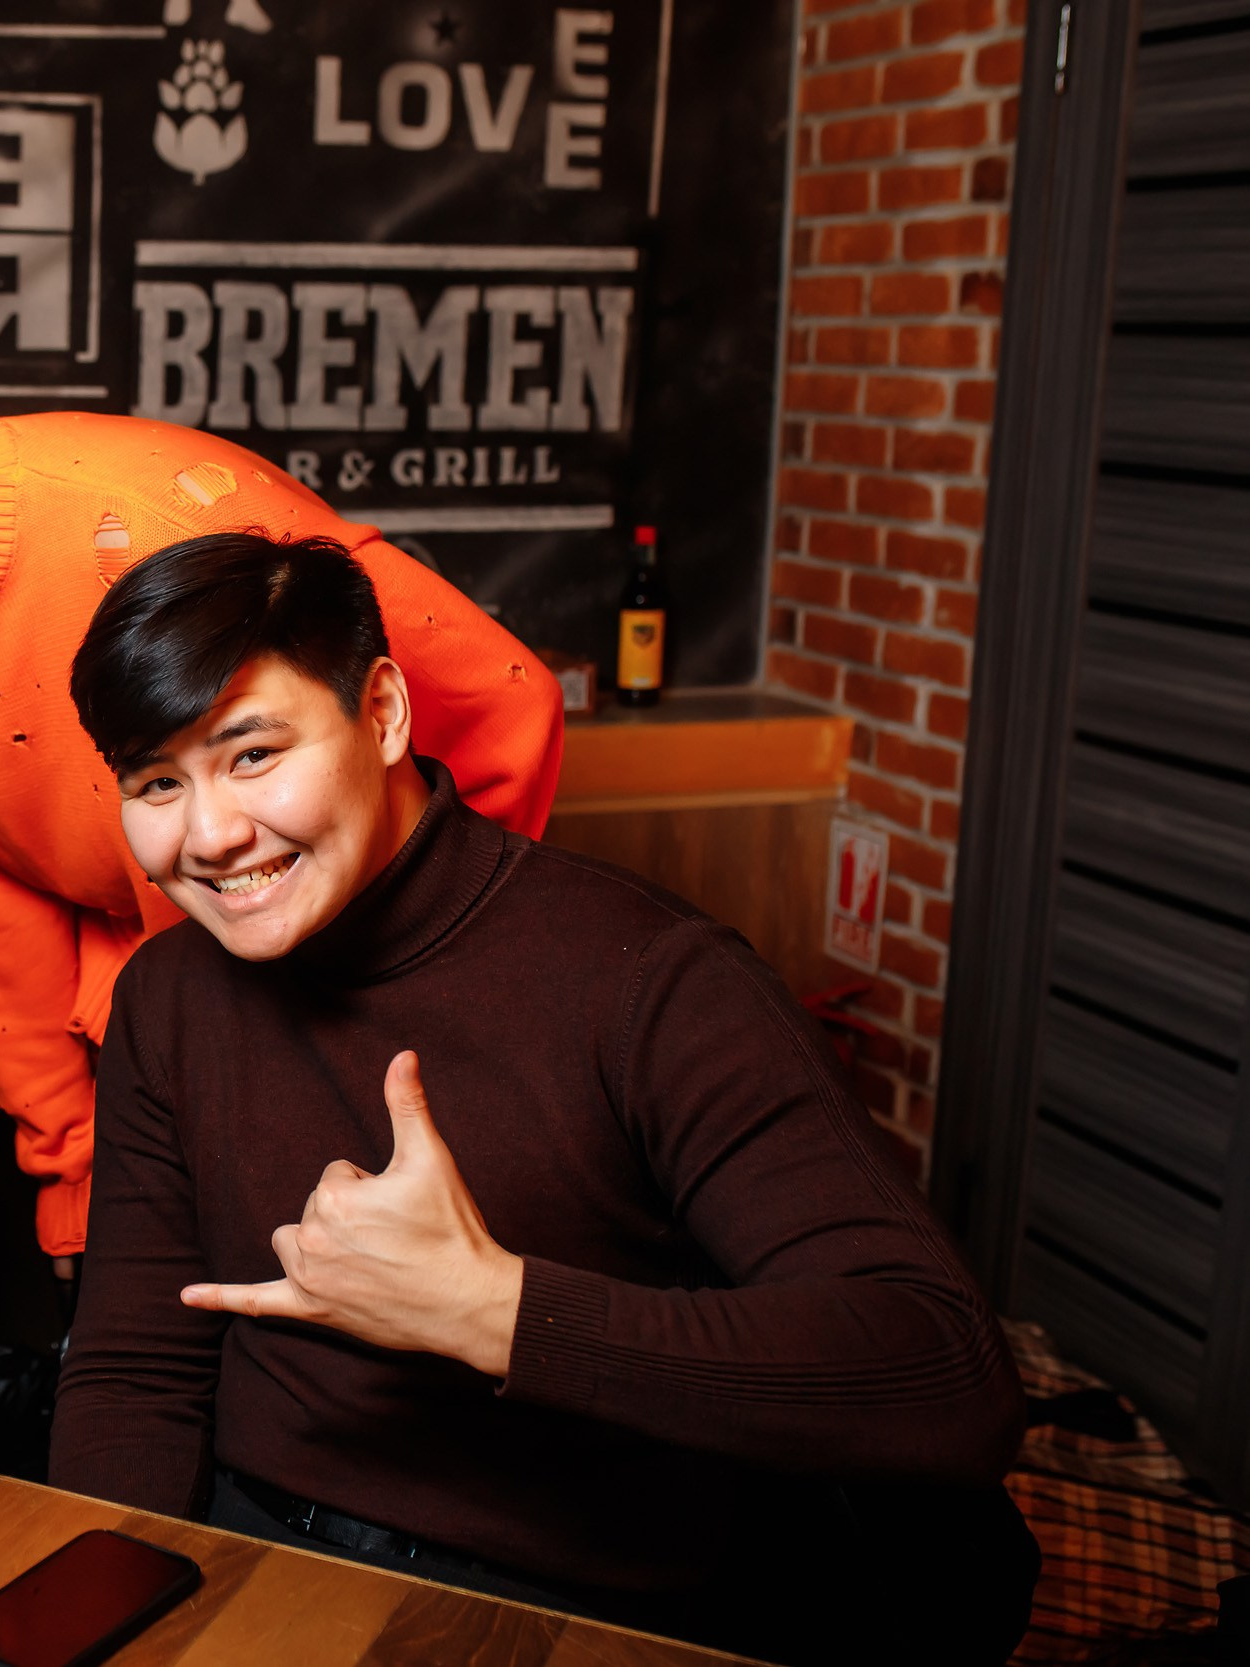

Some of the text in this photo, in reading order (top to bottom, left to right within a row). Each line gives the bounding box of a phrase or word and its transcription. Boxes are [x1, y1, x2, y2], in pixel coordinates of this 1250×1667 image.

[132, 281, 635, 432] BREMEN
[337, 451, 375, 490] &
[390, 446, 561, 486] GRILL
